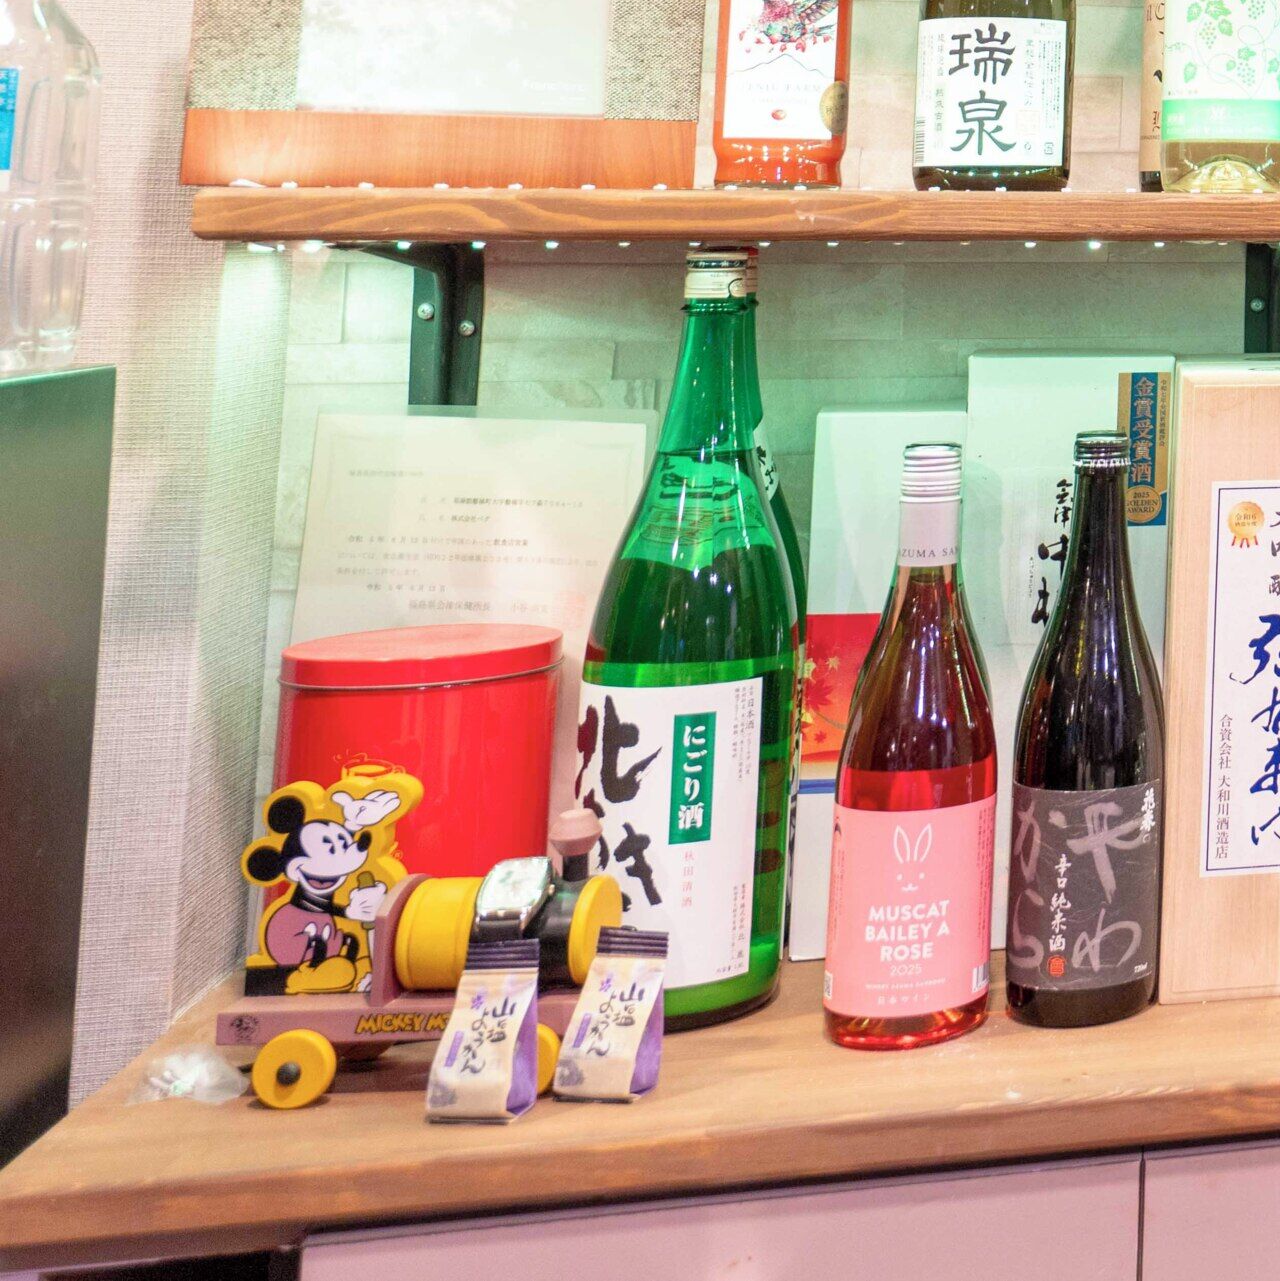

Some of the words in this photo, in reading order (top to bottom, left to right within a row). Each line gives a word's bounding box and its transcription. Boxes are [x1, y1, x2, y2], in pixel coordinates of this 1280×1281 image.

[948, 21, 1018, 157] 瑞泉
[1131, 376, 1155, 483] 金賞受賞酒
[1132, 491, 1151, 499] 2025
[1218, 714, 1233, 770] 合資会社
[678, 724, 708, 831] にごり酒
[1215, 773, 1231, 860] 大和川酒造店
[680, 849, 696, 908] 秋田清酒
[1048, 853, 1072, 953] 辛口純米酒
[864, 921, 934, 943] BAILEY
[936, 924, 951, 937] A
[867, 899, 951, 922] MUSCAT
[880, 941, 934, 963] ROSE
[355, 1014, 424, 1035] MICKEY
